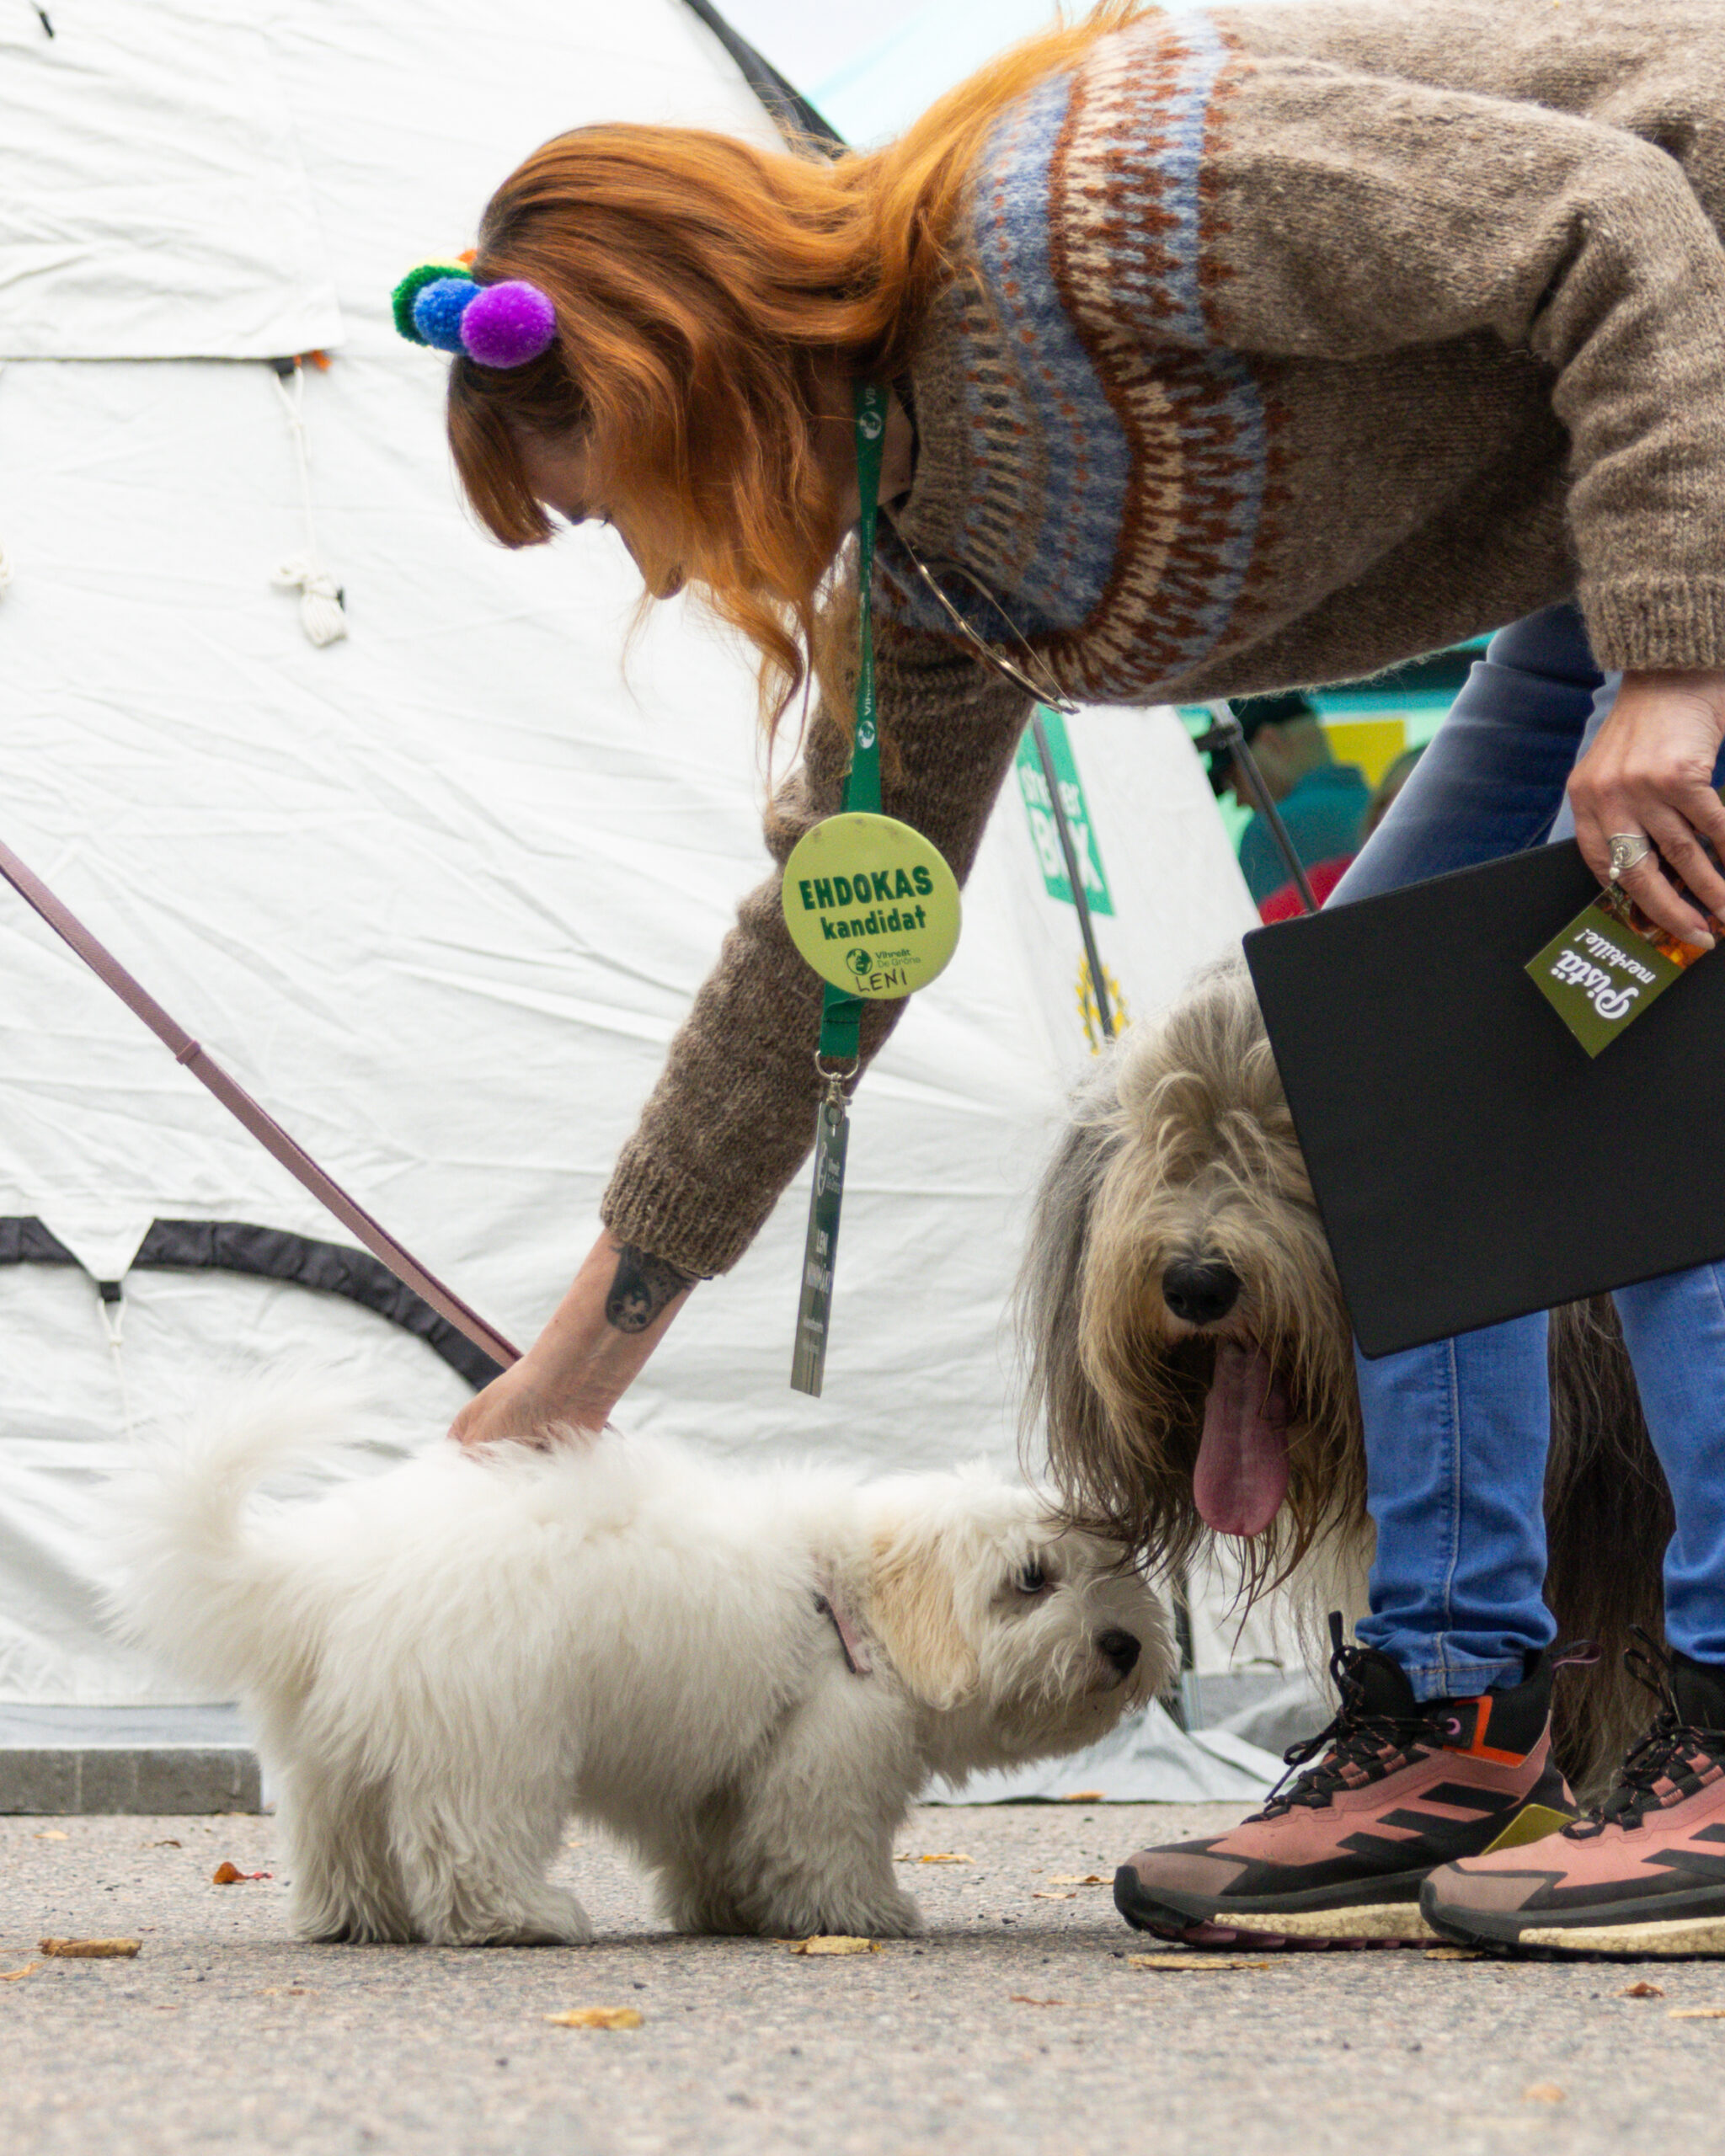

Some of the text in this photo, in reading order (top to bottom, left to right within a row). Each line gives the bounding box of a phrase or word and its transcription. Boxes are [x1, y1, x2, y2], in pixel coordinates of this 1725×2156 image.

[798, 865, 934, 910] EHDOKAS
[820, 905, 927, 940] kandidat
[875, 948, 911, 959] Vihreät
[1573, 928, 1656, 984] merkille!
[855, 968, 907, 992] LENI
[1551, 949, 1639, 1019] Pistä
